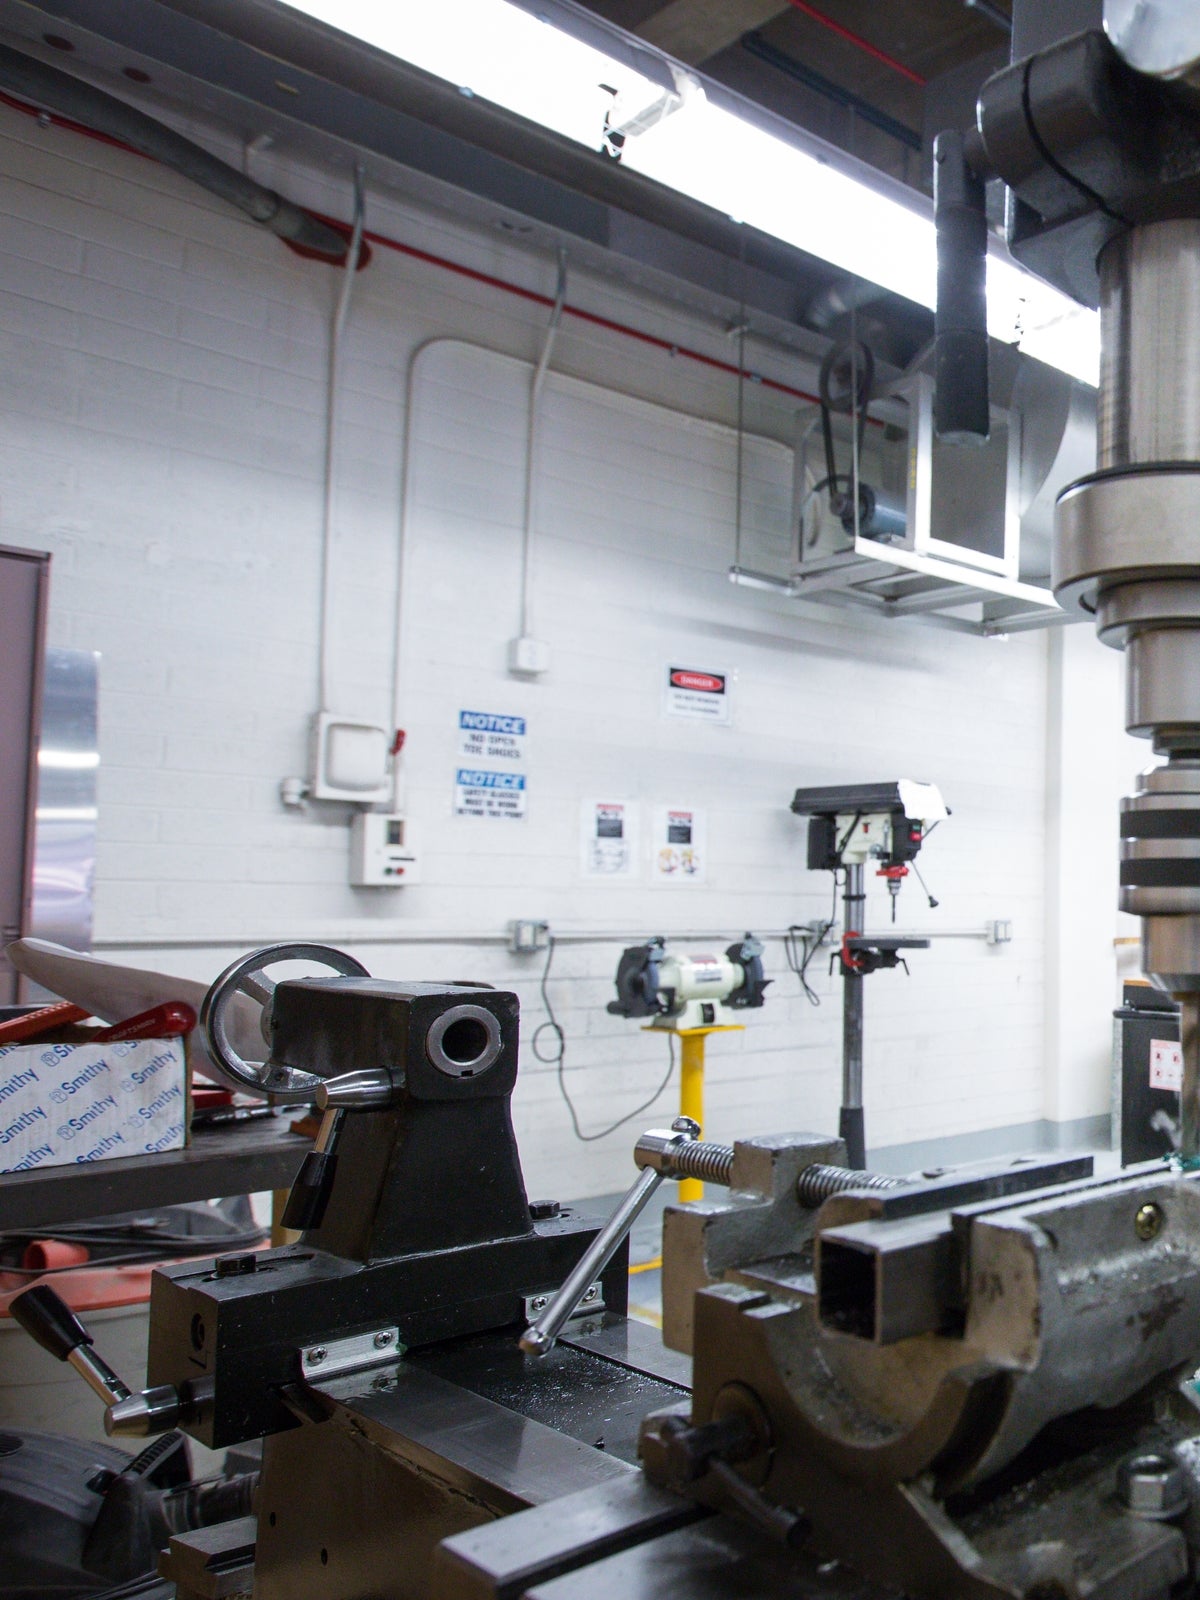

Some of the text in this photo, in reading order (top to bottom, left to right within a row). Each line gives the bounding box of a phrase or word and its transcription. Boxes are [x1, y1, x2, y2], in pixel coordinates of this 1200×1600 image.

[462, 713, 523, 733] NOTICE
[460, 770, 521, 789] NOTICE
[61, 1058, 111, 1094] Smithy
[131, 1050, 177, 1085] Smithy
[0, 1068, 40, 1104] mithy
[138, 1084, 183, 1119] Smithy
[69, 1095, 118, 1131] Smithy
